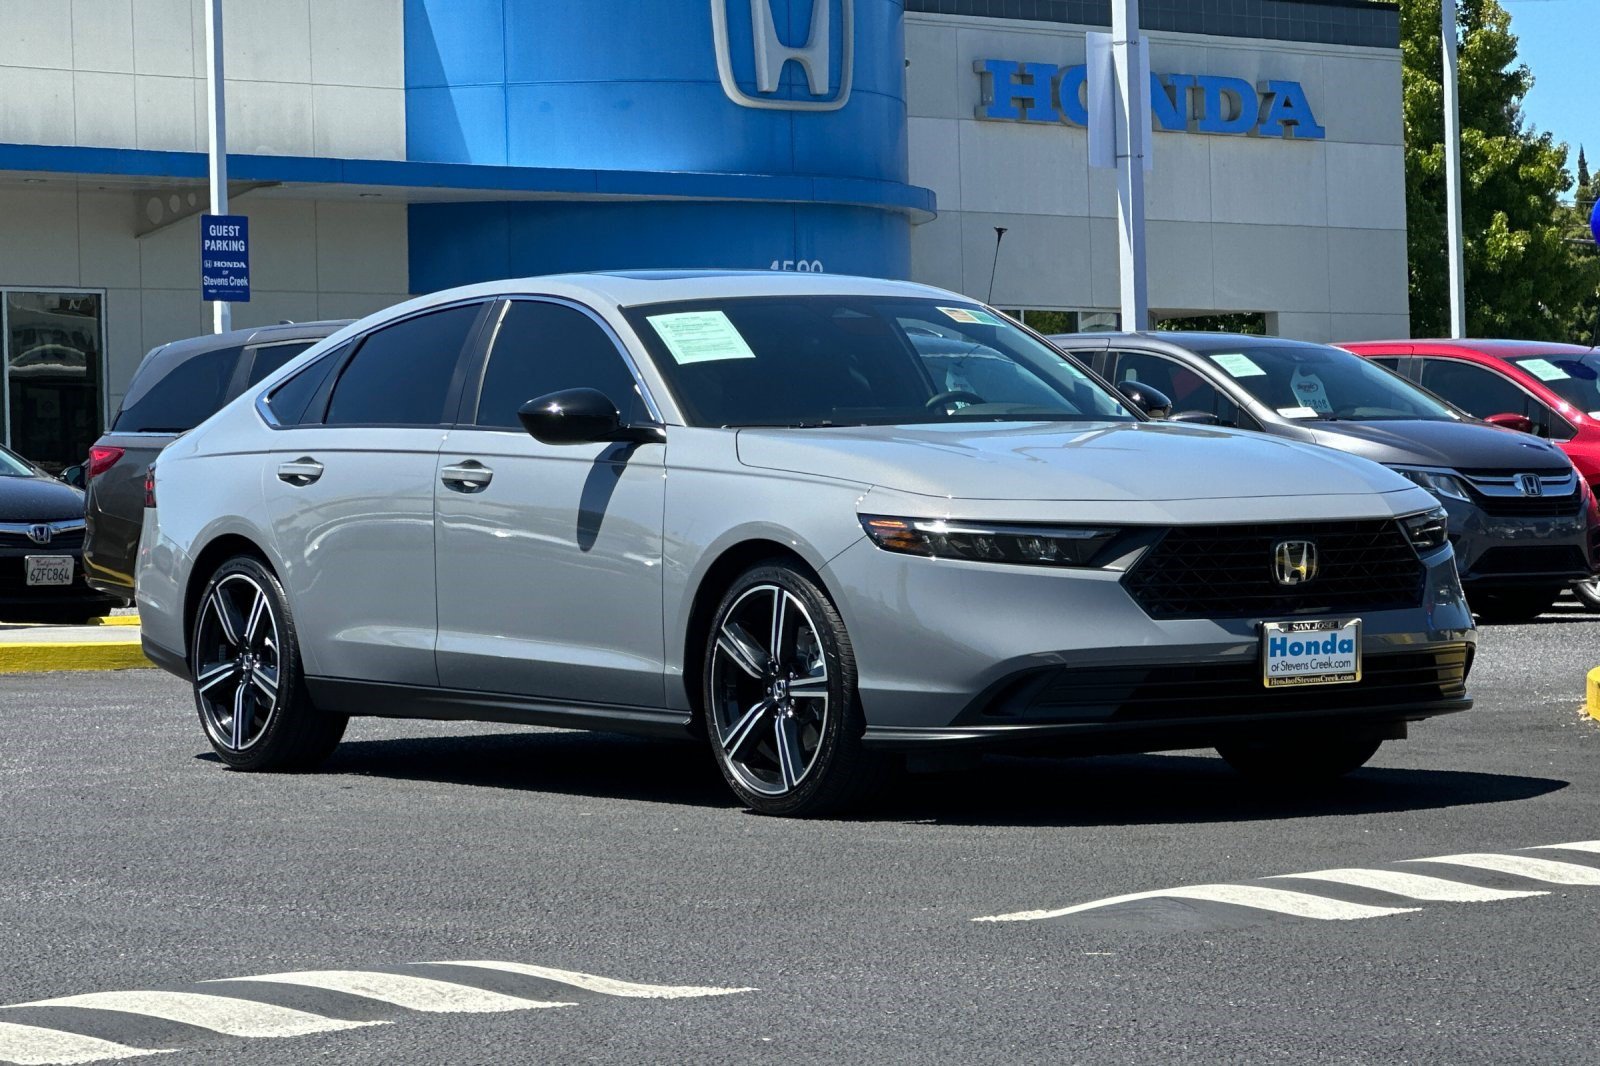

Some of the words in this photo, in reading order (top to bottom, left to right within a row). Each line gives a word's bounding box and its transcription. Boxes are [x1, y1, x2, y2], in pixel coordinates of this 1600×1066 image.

[209, 225, 240, 236] GUEST
[204, 240, 245, 251] PARKING
[203, 275, 228, 286] Stevens
[229, 276, 248, 287] Creek
[30, 567, 70, 581] 6ZFC864
[1292, 622, 1311, 631] SAN
[1312, 621, 1334, 630] JOSE
[1270, 633, 1353, 657] Honda
[1271, 663, 1280, 672] of
[1280, 660, 1309, 672] Stevens
[1310, 656, 1351, 670] Creek.com
